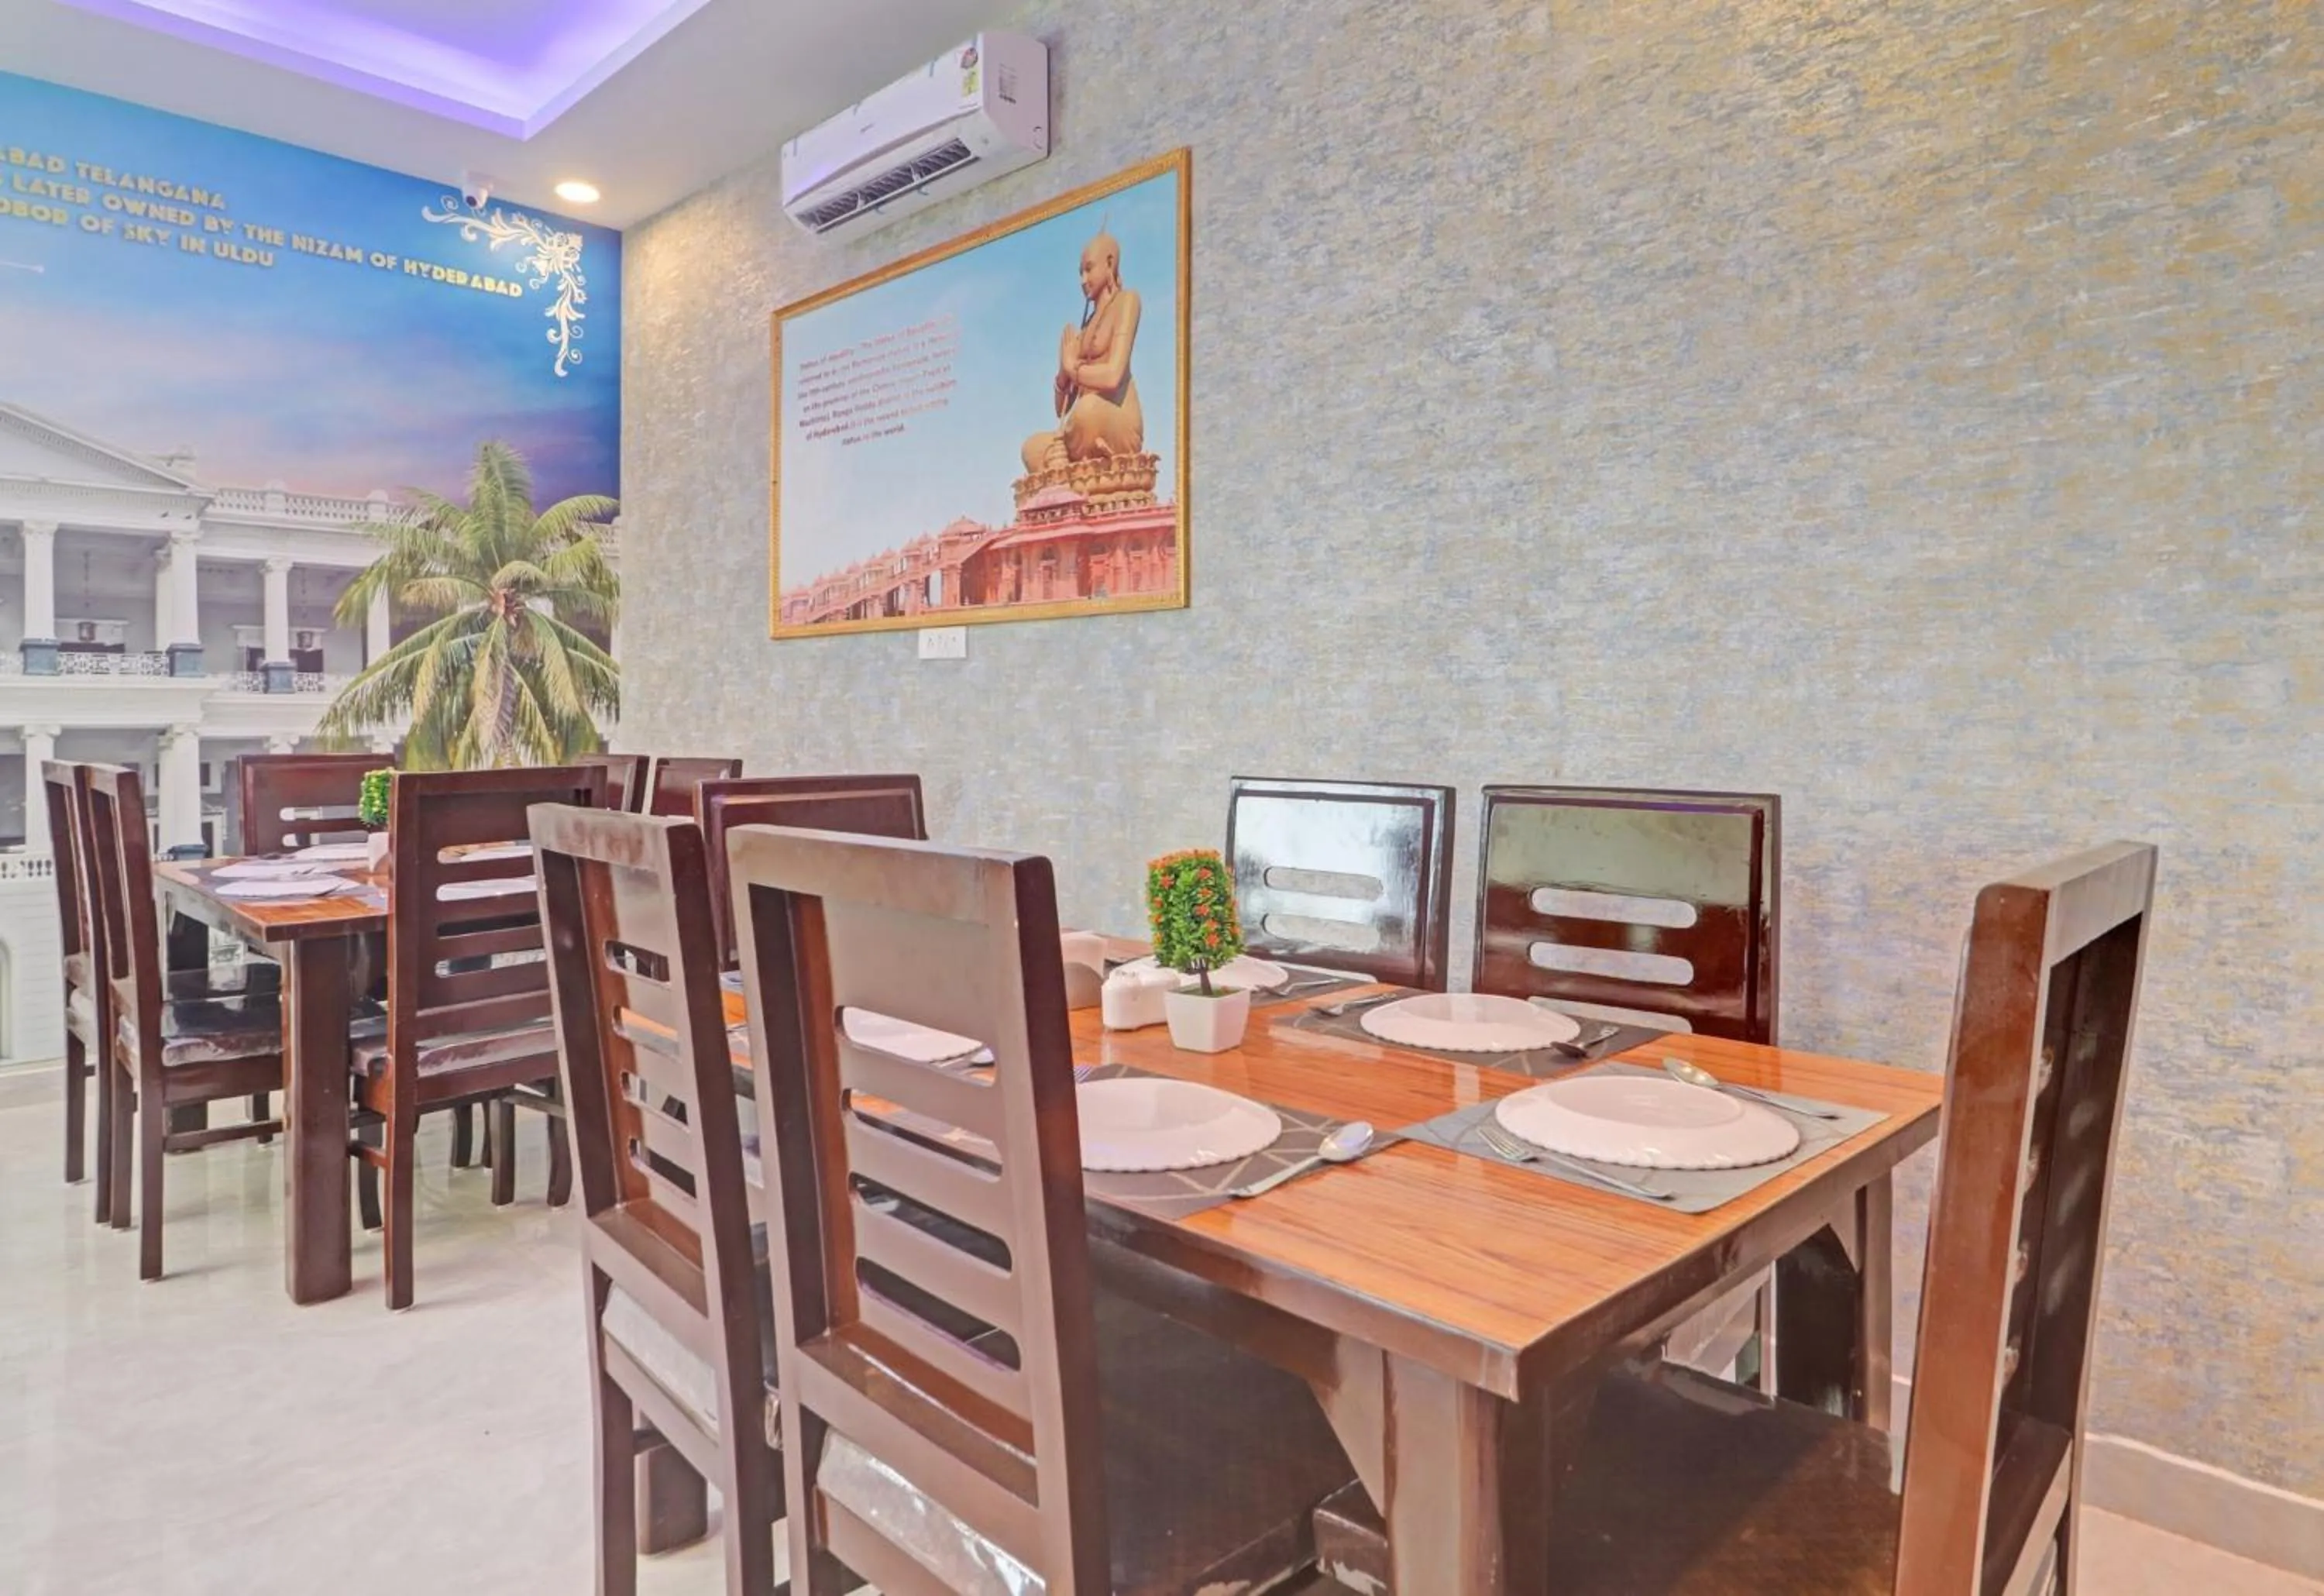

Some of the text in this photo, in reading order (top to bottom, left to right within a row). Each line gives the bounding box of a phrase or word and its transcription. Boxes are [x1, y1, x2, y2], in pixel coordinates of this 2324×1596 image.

[76, 161, 226, 211] TELANGANA
[13, 173, 523, 298] LATER OWNED BY THE NIZAM OF HYDERABAD
[80, 214, 114, 234] OF
[124, 222, 170, 246] SKY
[180, 235, 206, 254] IN
[213, 240, 273, 267] ULDU
